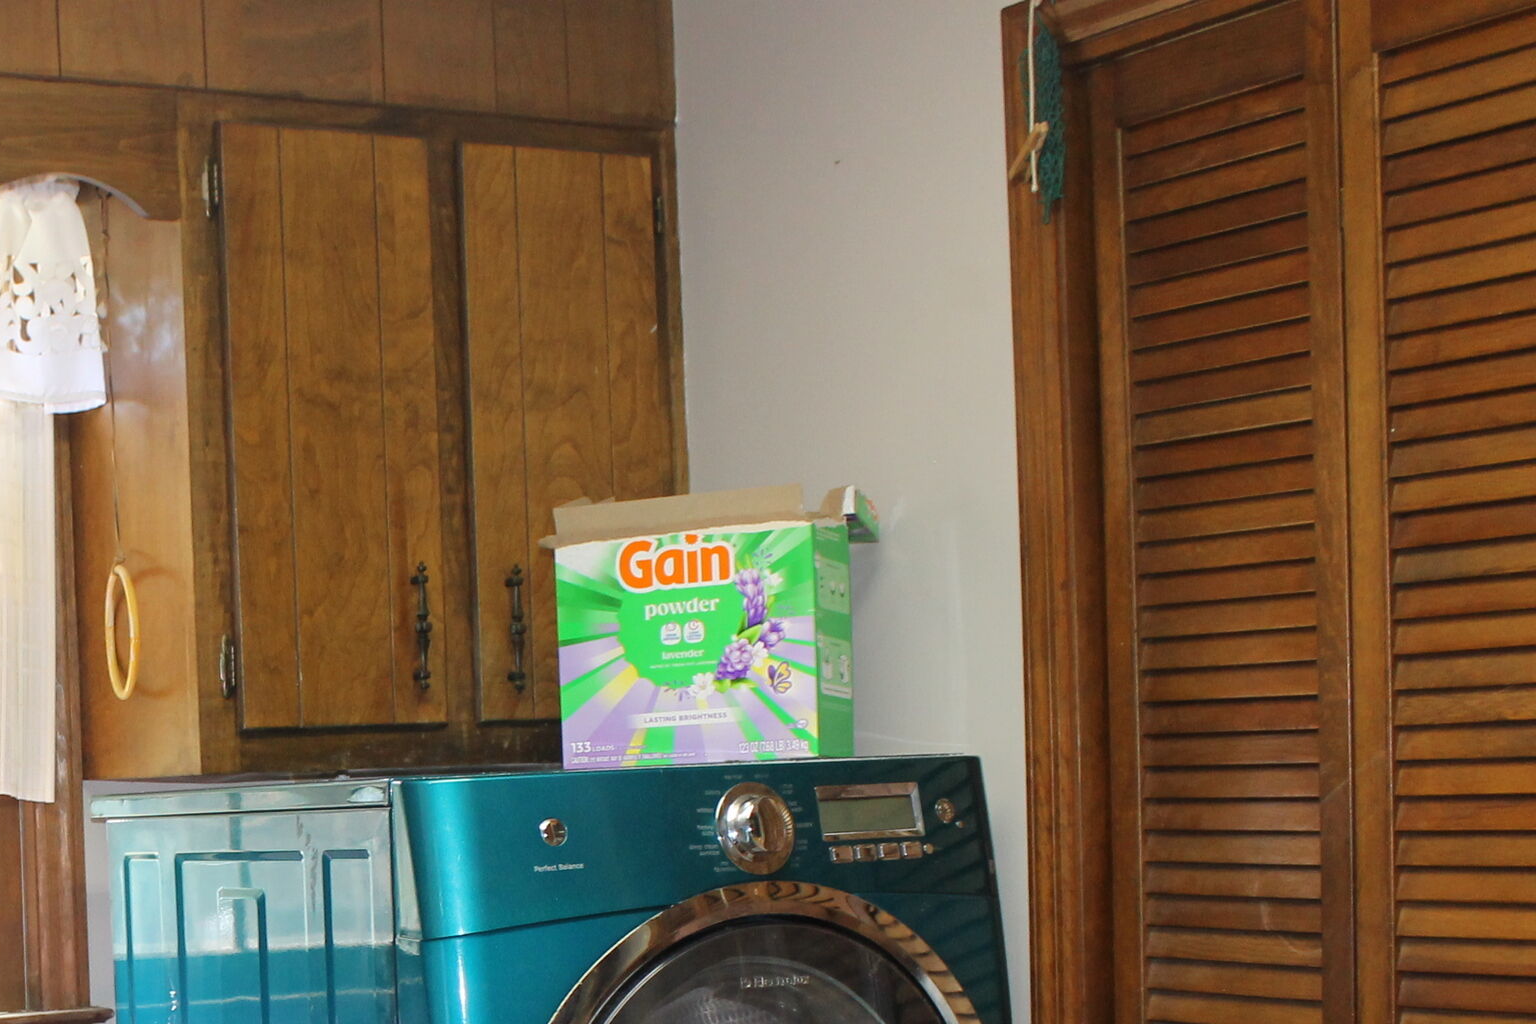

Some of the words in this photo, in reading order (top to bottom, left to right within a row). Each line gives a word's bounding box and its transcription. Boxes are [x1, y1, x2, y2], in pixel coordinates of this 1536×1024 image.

[618, 533, 731, 590] Gain
[644, 597, 720, 621] powder
[661, 649, 705, 661] lavender
[643, 713, 677, 724] LASTING
[678, 710, 728, 722] BRIGHTNESS
[570, 741, 592, 753] 133
[592, 744, 616, 752] LOADS
[558, 863, 584, 871] Balance
